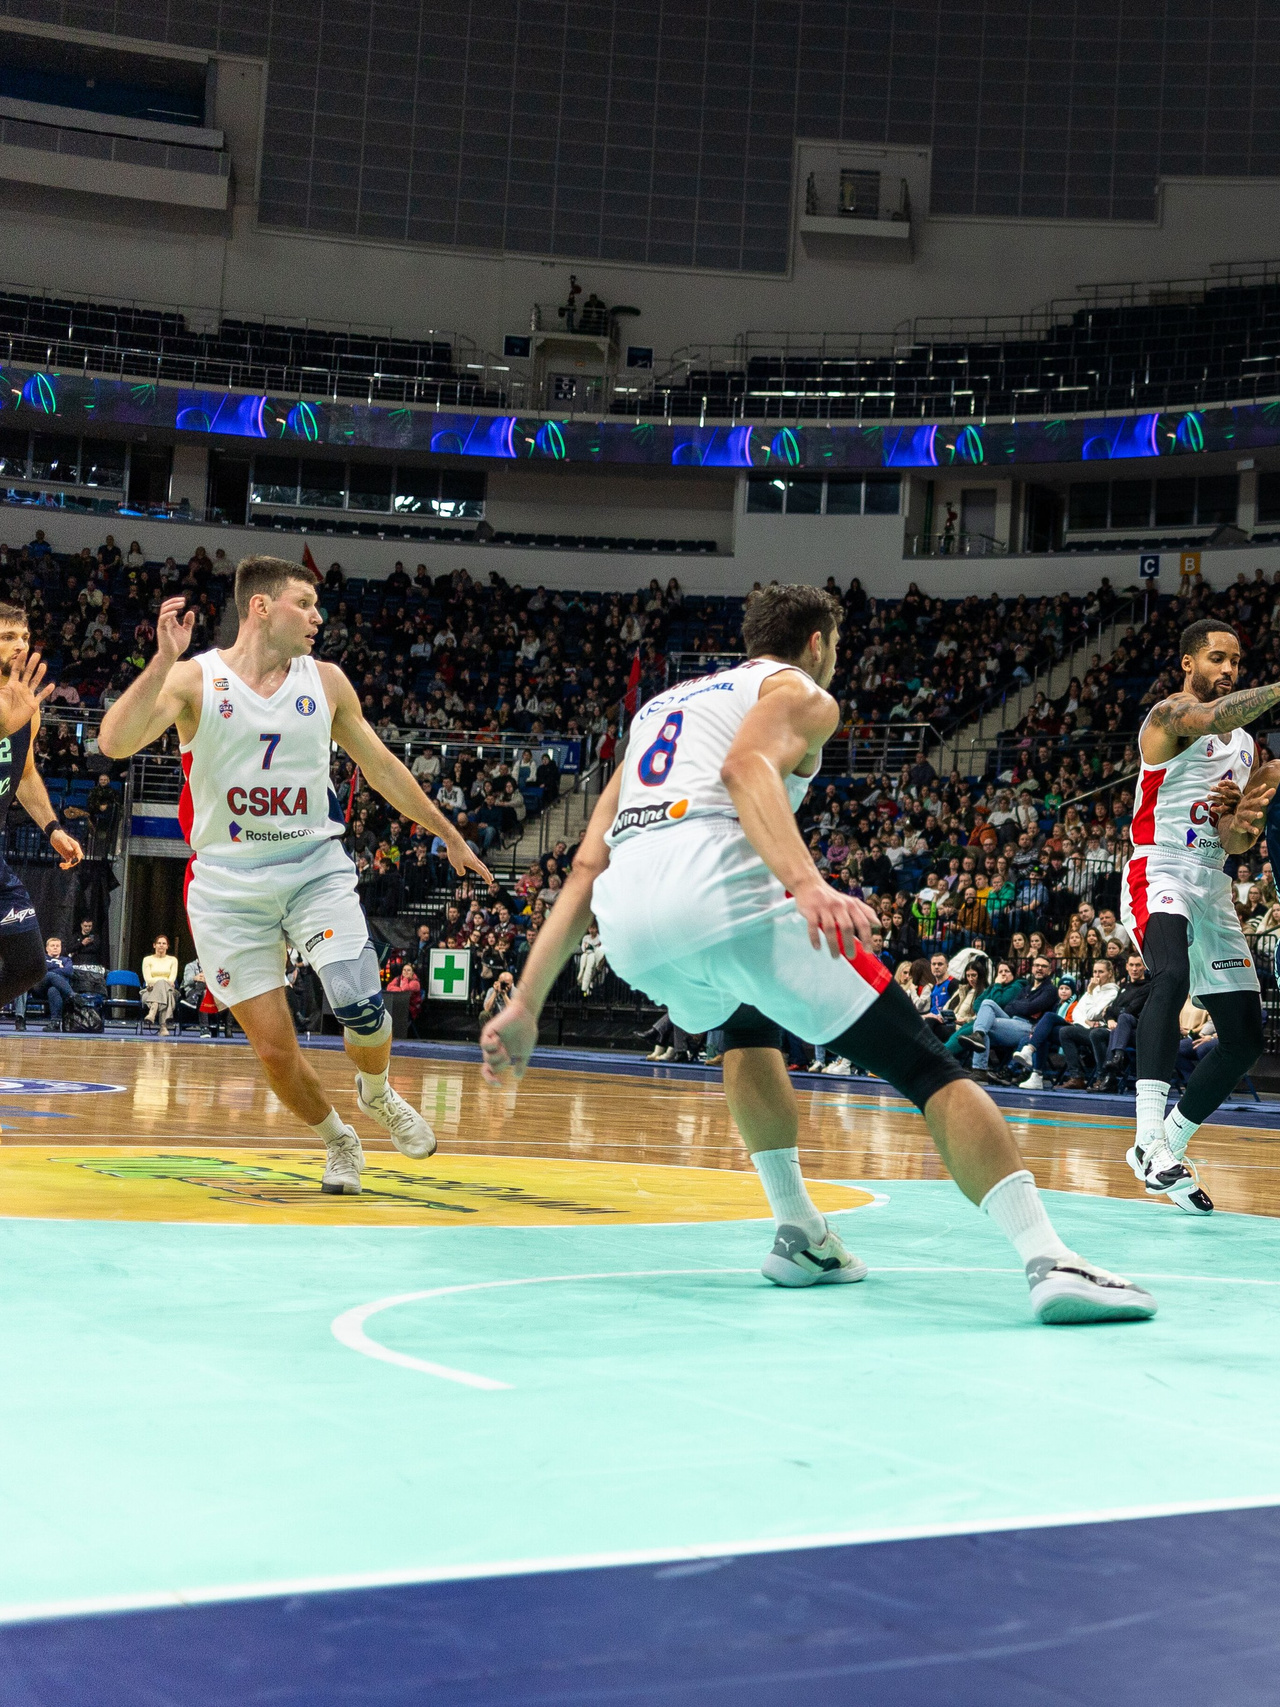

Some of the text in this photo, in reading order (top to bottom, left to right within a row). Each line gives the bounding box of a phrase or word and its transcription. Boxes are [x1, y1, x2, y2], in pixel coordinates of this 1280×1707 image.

[1144, 559, 1155, 574] C
[1185, 558, 1195, 571] B
[260, 733, 281, 770] 7
[637, 710, 684, 787] 8
[227, 787, 308, 816] CSKA
[246, 828, 315, 842] Rostelecom
[1213, 961, 1243, 969] Winline
